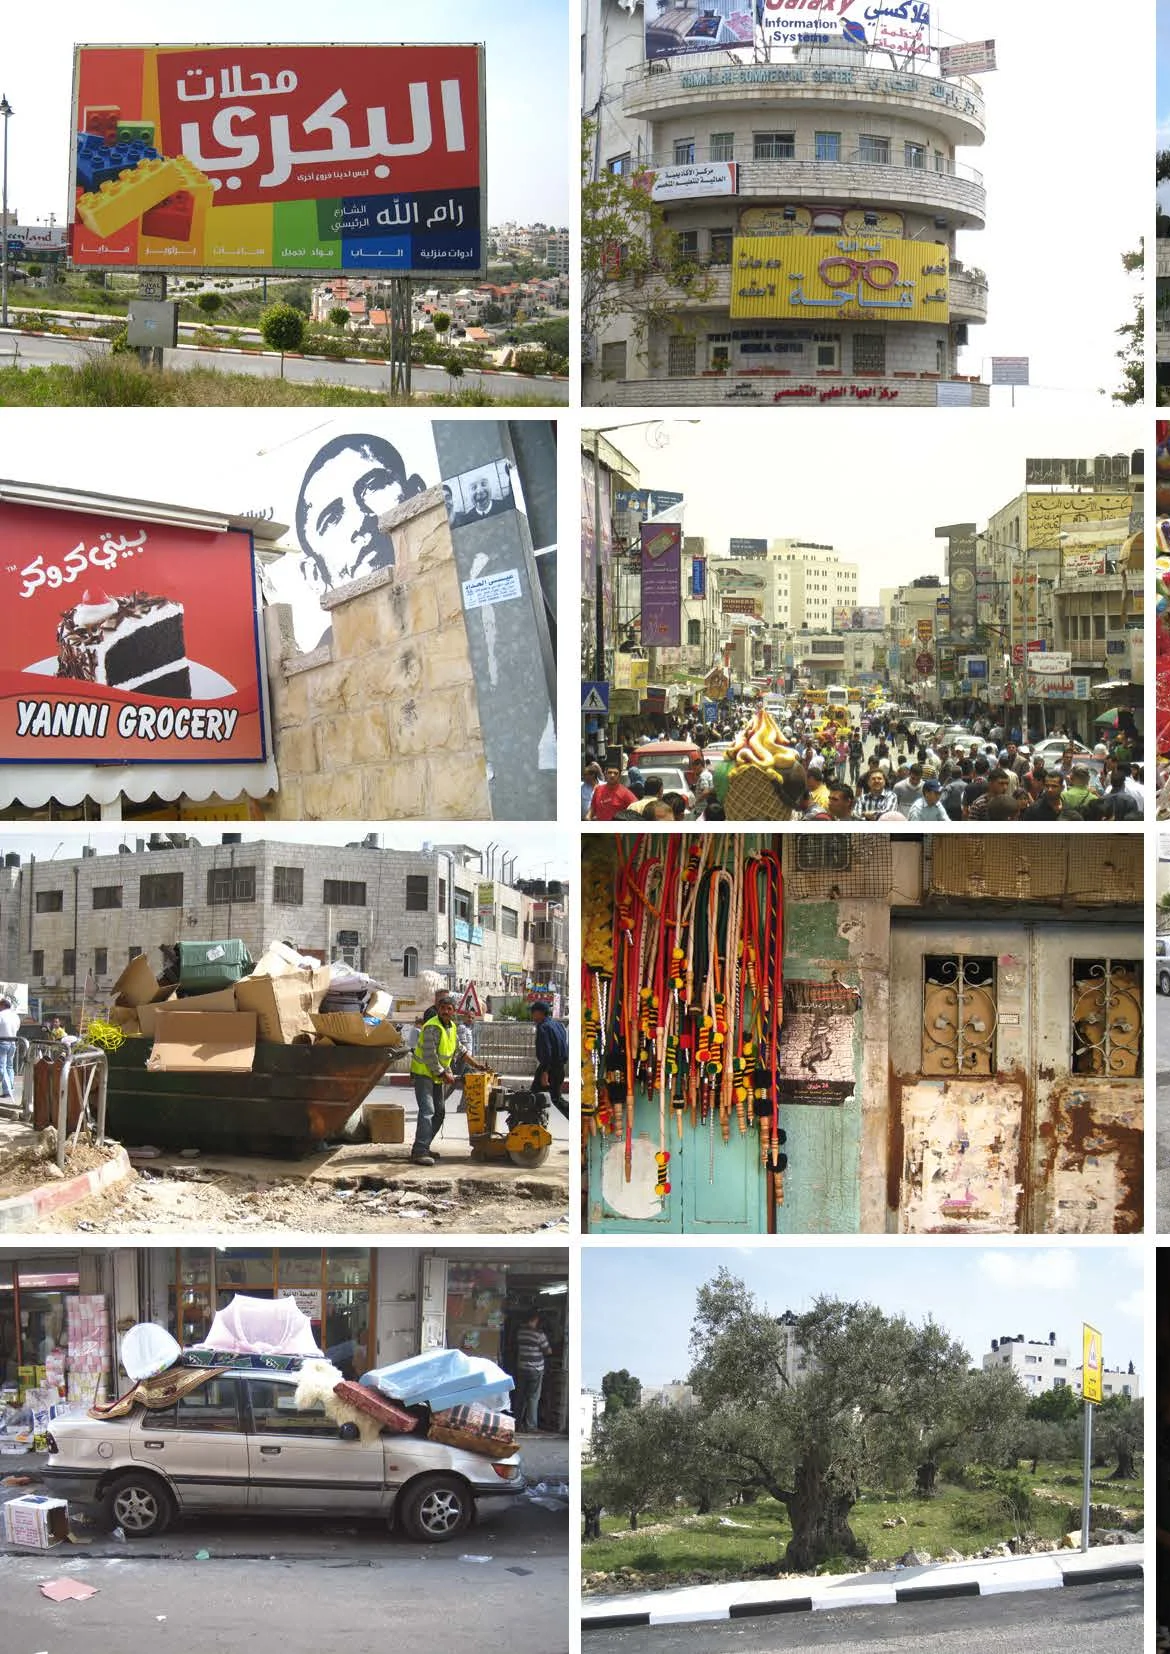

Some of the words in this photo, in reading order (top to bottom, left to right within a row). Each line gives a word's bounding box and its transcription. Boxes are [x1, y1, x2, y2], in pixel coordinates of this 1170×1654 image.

[765, 17, 837, 28] Information
[773, 31, 829, 43] Systems
[176, 65, 299, 103] محلات
[181, 79, 467, 191] البكري
[333, 170, 352, 178] لدينا
[353, 169, 369, 179] ليس
[333, 204, 367, 218] الشارع
[426, 198, 465, 228] رام
[331, 217, 370, 232] الرئيسي
[89, 529, 148, 570] بيتي
[19, 542, 89, 598] كروكر
[16, 701, 110, 738] YANNI
[118, 703, 239, 742] GROCERY
